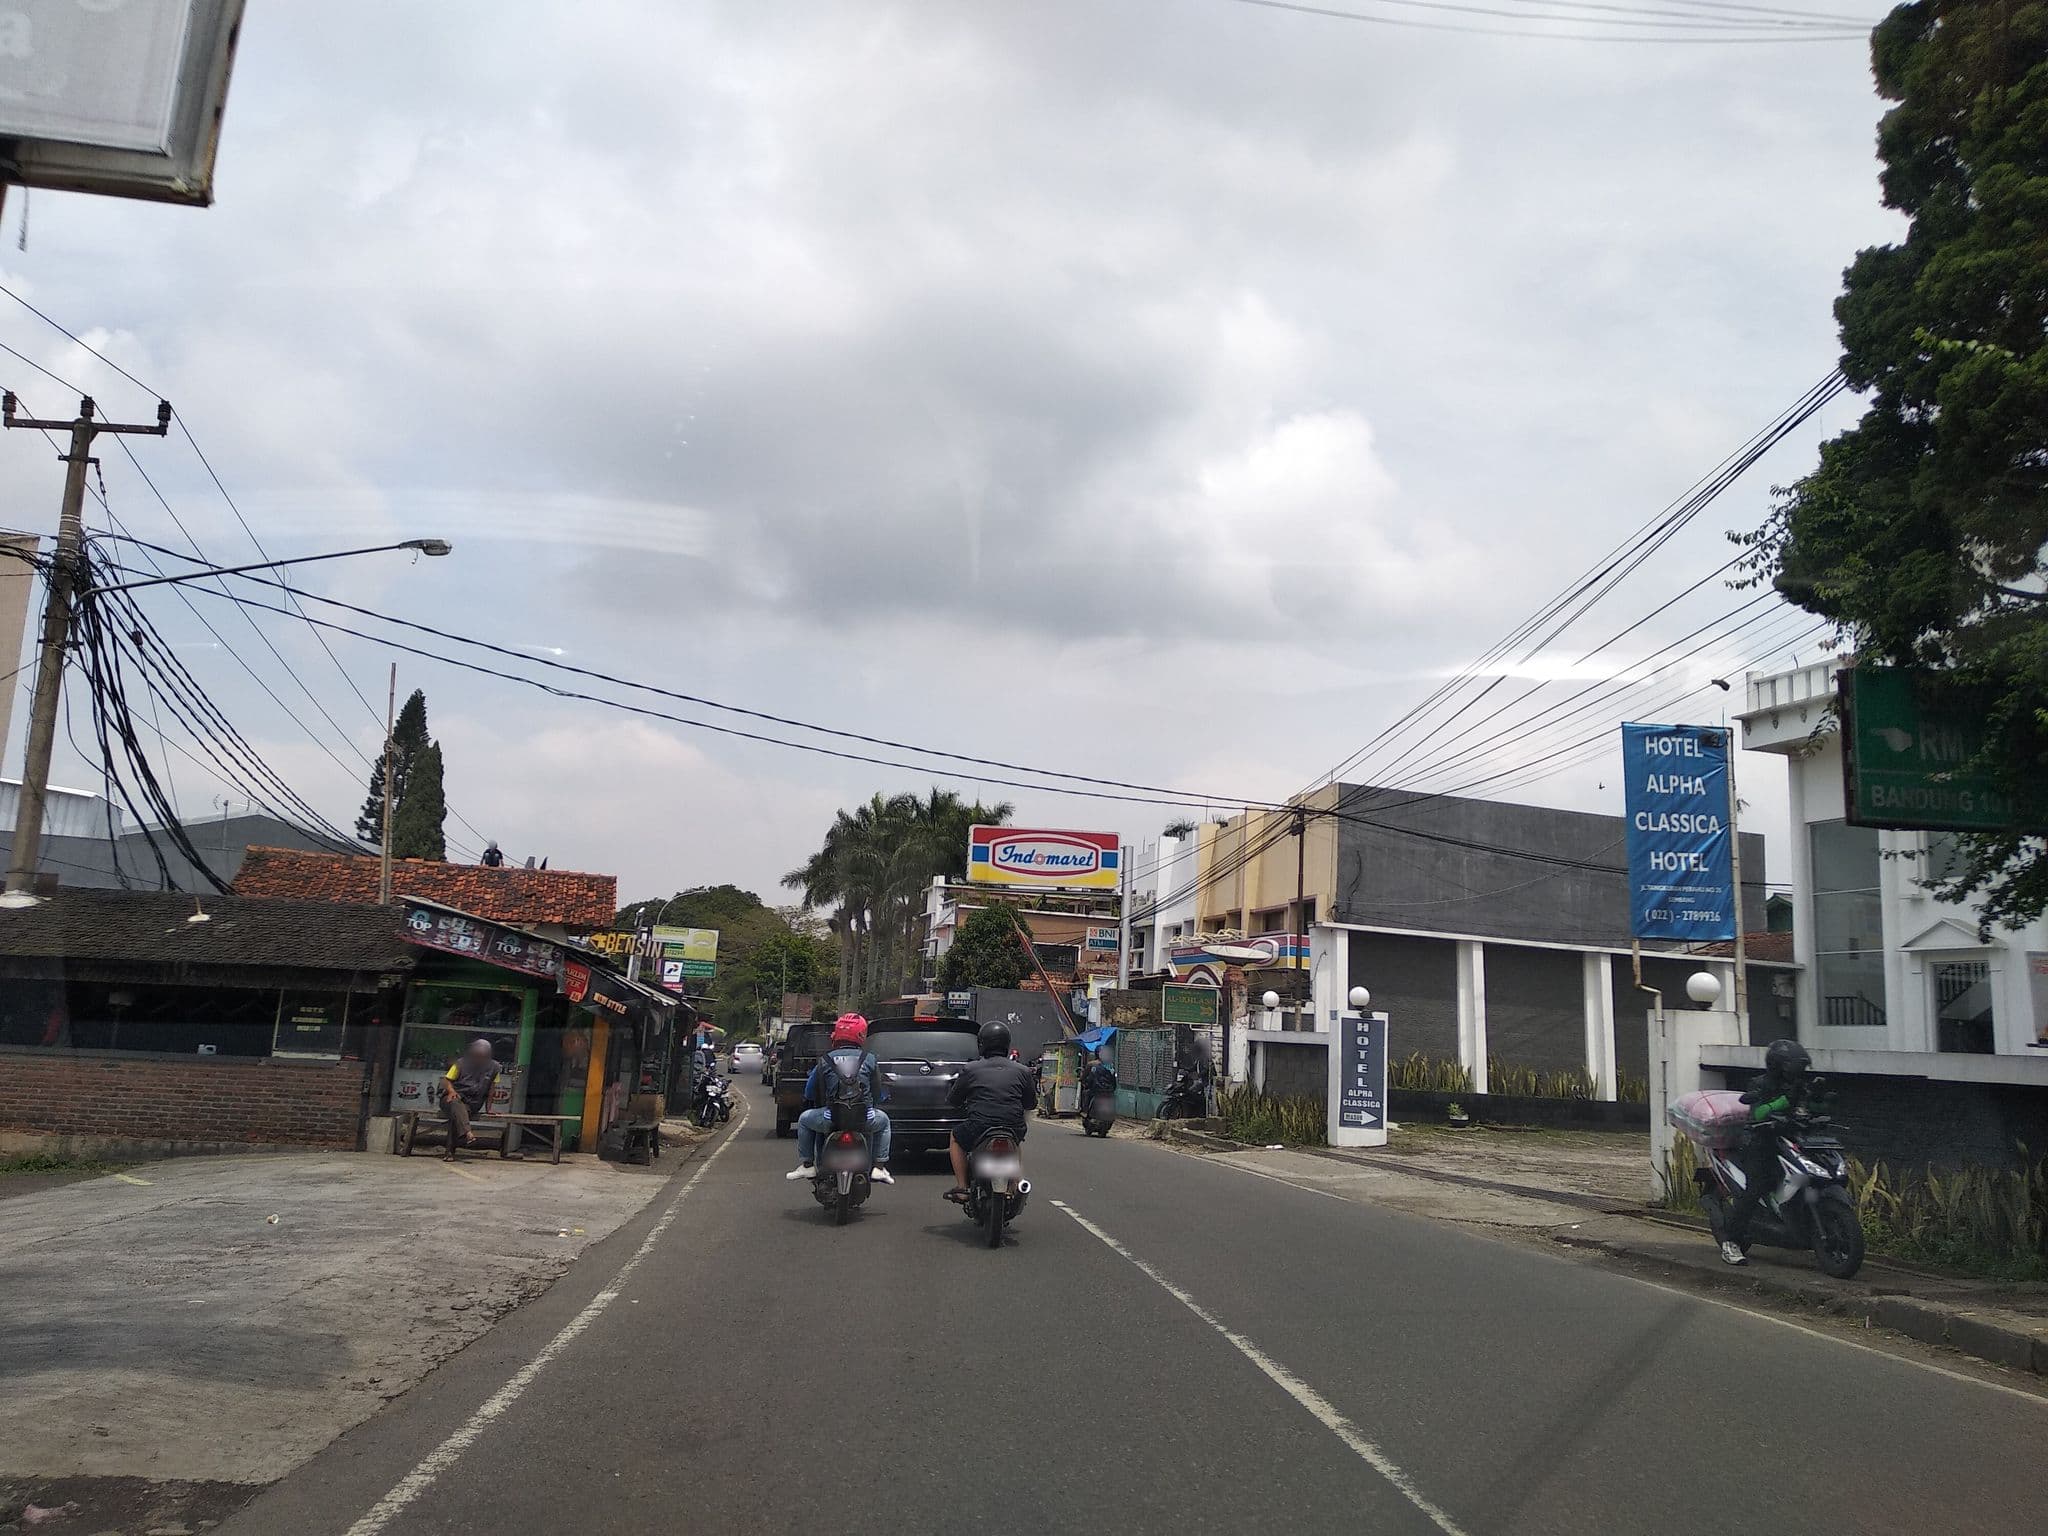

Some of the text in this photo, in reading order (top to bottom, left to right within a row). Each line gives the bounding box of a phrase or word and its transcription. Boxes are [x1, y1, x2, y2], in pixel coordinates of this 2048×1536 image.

[1645, 736, 1704, 758] HOTEL
[1646, 774, 1706, 795] ALPHA
[1635, 811, 1720, 834] CLASSICA
[998, 845, 1094, 867] Indomaret
[1650, 851, 1709, 872] HOTEL
[405, 917, 433, 932] TOP
[1098, 928, 1115, 938] BNI
[495, 941, 522, 955] TOP
[605, 933, 662, 959] BENSIN
[607, 999, 627, 1015] STYLE
[1356, 1022, 1369, 1087] HOTEL
[1343, 1099, 1380, 1108] CLASSICA
[1348, 1089, 1373, 1097] ALPHA
